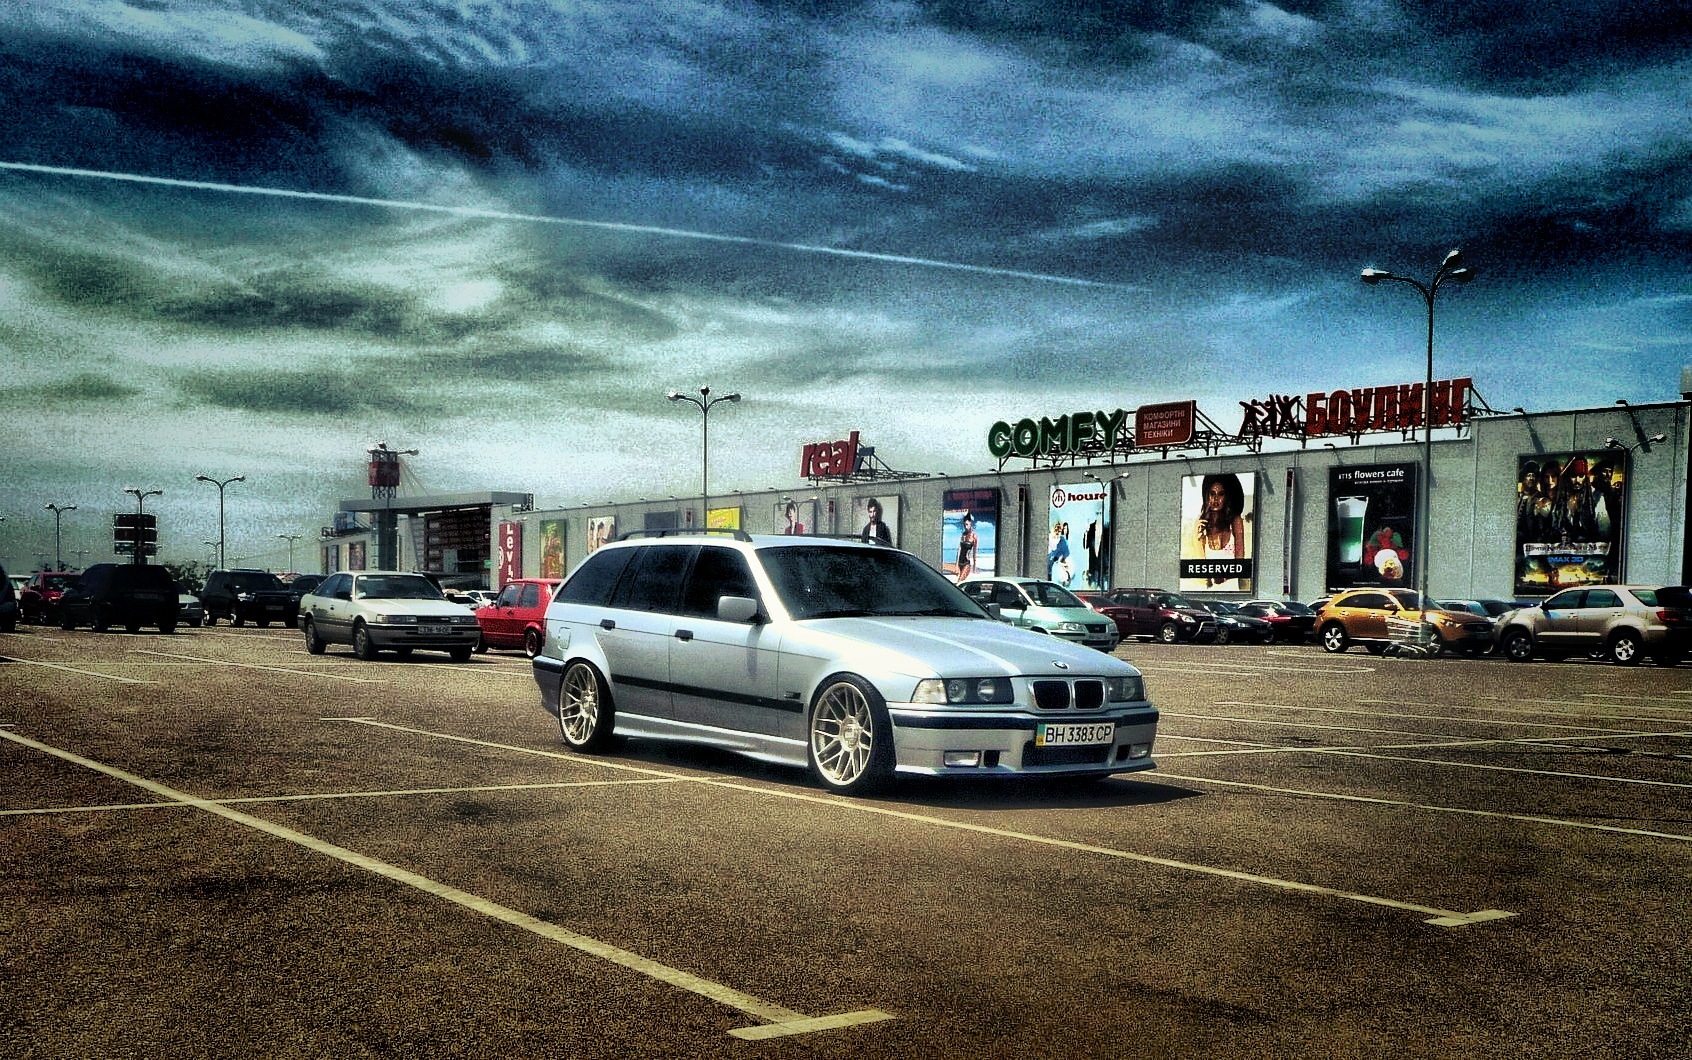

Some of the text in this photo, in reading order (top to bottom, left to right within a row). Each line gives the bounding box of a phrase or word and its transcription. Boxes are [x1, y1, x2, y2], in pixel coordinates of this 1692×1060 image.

[1307, 378, 1472, 436] БОУЛИНГ
[1143, 410, 1185, 421] КОМФОРТНІ
[1143, 419, 1181, 430] МАГАЗИНИ
[988, 408, 1127, 458] COMFY
[1143, 429, 1173, 439] ТЕХНІКИ
[800, 431, 860, 478] real
[1354, 470, 1385, 479] flowers
[1386, 468, 1404, 477] cafe
[1188, 563, 1243, 574] RESERVED
[1045, 727, 1065, 743] BH
[1067, 726, 1094, 742] 3383
[1096, 726, 1112, 741] CP
